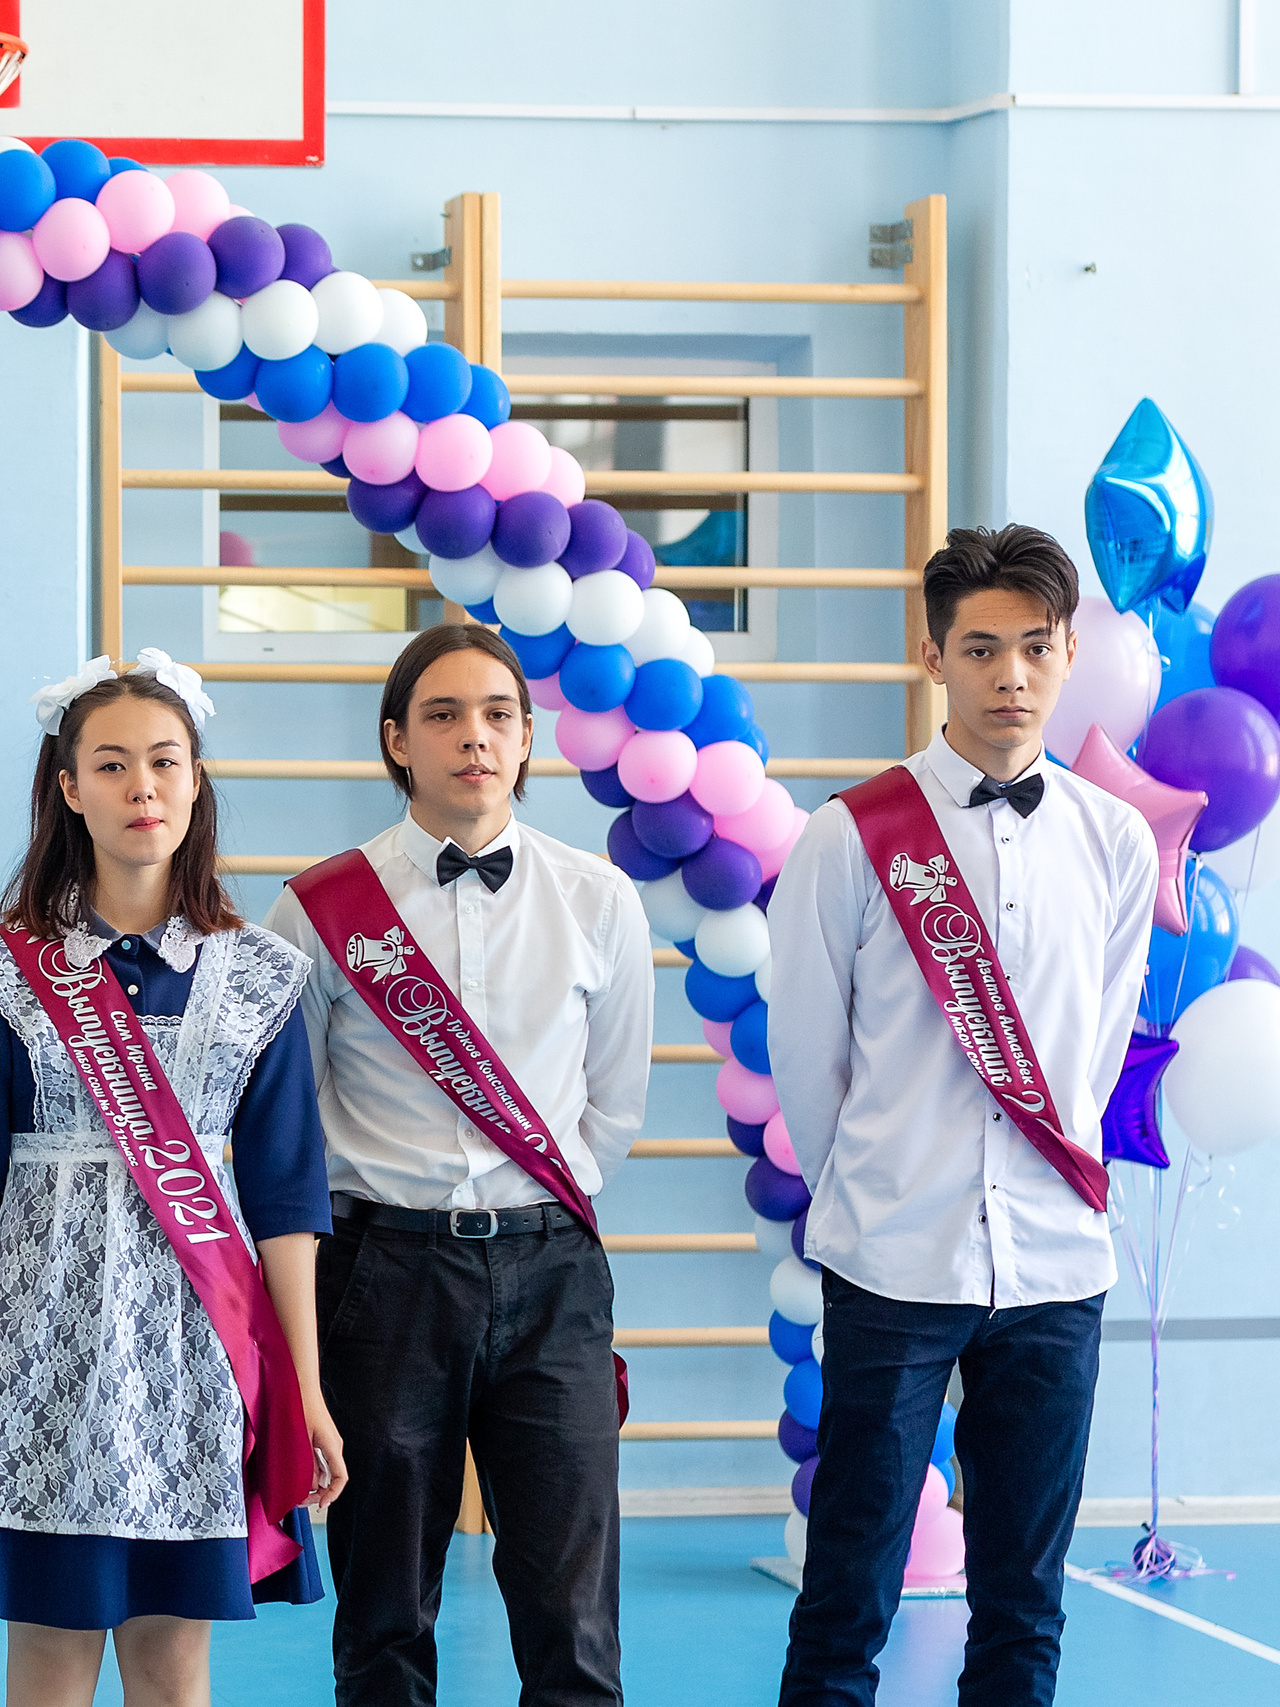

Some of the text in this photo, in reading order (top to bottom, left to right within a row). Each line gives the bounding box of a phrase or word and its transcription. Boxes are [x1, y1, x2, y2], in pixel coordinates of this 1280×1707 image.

[920, 902, 1013, 1087] Выпускник
[948, 1015, 974, 1051] МБОУ
[976, 957, 1005, 1011] Азатов
[998, 1014, 1035, 1085] Алмазбек
[38, 940, 231, 1244] Выпускница 2021
[73, 1049, 93, 1077] МБОУ
[88, 1075, 106, 1100] СОШ
[109, 1010, 158, 1092] Сим Ирина
[447, 1019, 532, 1131] Гудков Константин
